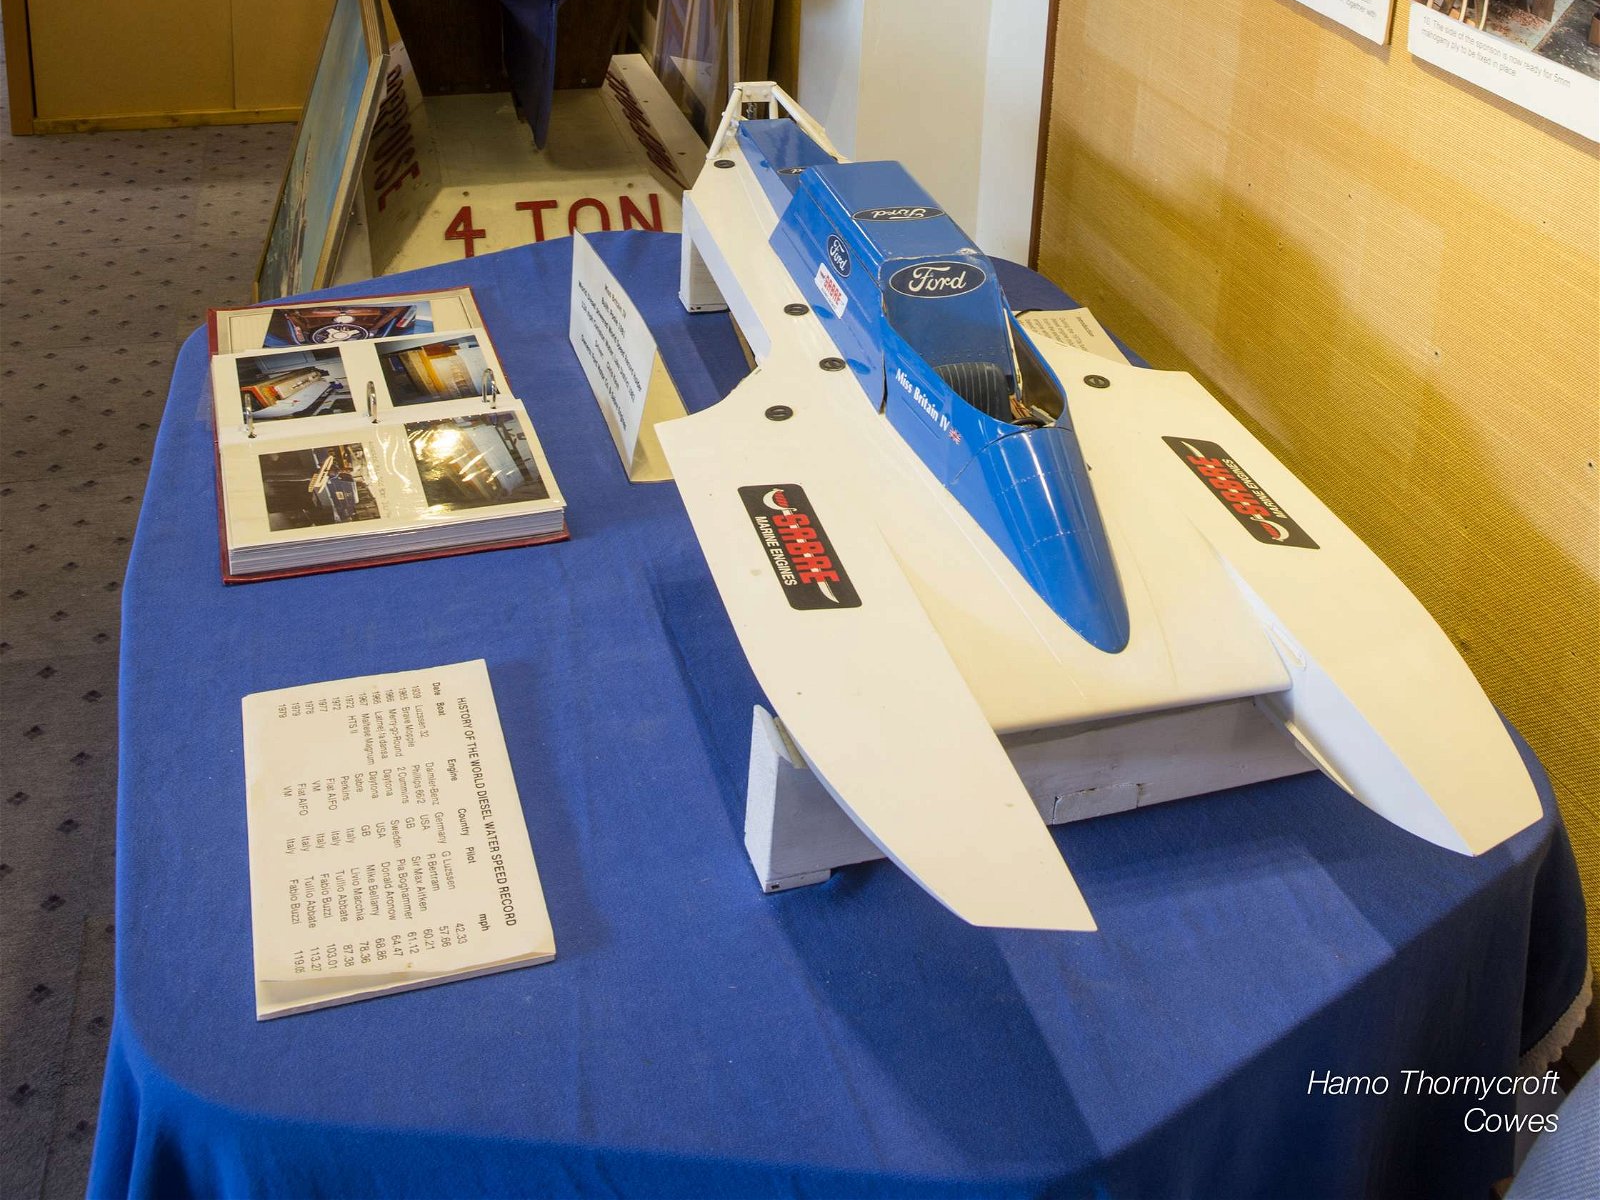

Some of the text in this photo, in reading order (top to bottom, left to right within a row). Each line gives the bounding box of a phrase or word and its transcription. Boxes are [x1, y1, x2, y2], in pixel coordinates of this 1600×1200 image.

[872, 207, 927, 220] Ford
[445, 193, 663, 258] 4 TON
[830, 240, 845, 271] Ford
[908, 266, 966, 292] Ford
[895, 368, 950, 431] Miss Britain IV
[1186, 455, 1272, 518] SABRE
[1222, 459, 1287, 519] MARINE ENGINES
[755, 516, 798, 586] MARINE ENGINES
[772, 513, 840, 584] SABRE
[347, 714, 357, 728] HTS
[363, 737, 374, 765] Magnum
[297, 782, 306, 796] Fiat
[325, 777, 335, 791] Fiat
[340, 775, 350, 801] Perkins
[354, 772, 364, 792] Sabre
[367, 770, 379, 798] Daytona
[397, 771, 409, 804] Cummins
[431, 681, 491, 931] Date Boat Engine Country Pilot mph
[456, 696, 516, 926] HISTORY OF THE WORLD DIESEL WATER SPEED RECORD
[360, 824, 372, 836] GB
[375, 821, 386, 839] USA
[404, 816, 415, 829] GB
[418, 813, 430, 830] USA
[285, 837, 296, 854] Italy
[299, 835, 311, 851] Italy
[315, 832, 326, 848] Italy
[330, 830, 341, 846] Italy
[345, 827, 356, 843] Italy
[382, 768, 393, 796] Daytona
[390, 819, 402, 848] Sweden
[406, 931, 419, 954] 61.12
[410, 855, 421, 866] Sir
[426, 853, 436, 861] R
[319, 872, 330, 895] Fabio
[335, 869, 346, 892] Tullio
[350, 867, 360, 886] Livio
[366, 864, 375, 883] Mike
[380, 861, 394, 889] Donald
[412, 867, 423, 884] Max
[426, 860, 440, 891] Bertram
[433, 811, 447, 843] Germany
[455, 922, 468, 944] 42.33
[288, 878, 299, 901] Fabio
[303, 875, 315, 898] Tullio
[321, 896, 333, 918] Buzzi
[337, 894, 348, 922] Abbate
[368, 884, 379, 915] Bellamy
[384, 890, 396, 920] Aronow
[290, 902, 302, 924] Buzzi
[305, 898, 317, 928] Abbate
[390, 934, 403, 956] 64.47
[422, 928, 435, 950] 60.21
[326, 943, 338, 969] 103.01
